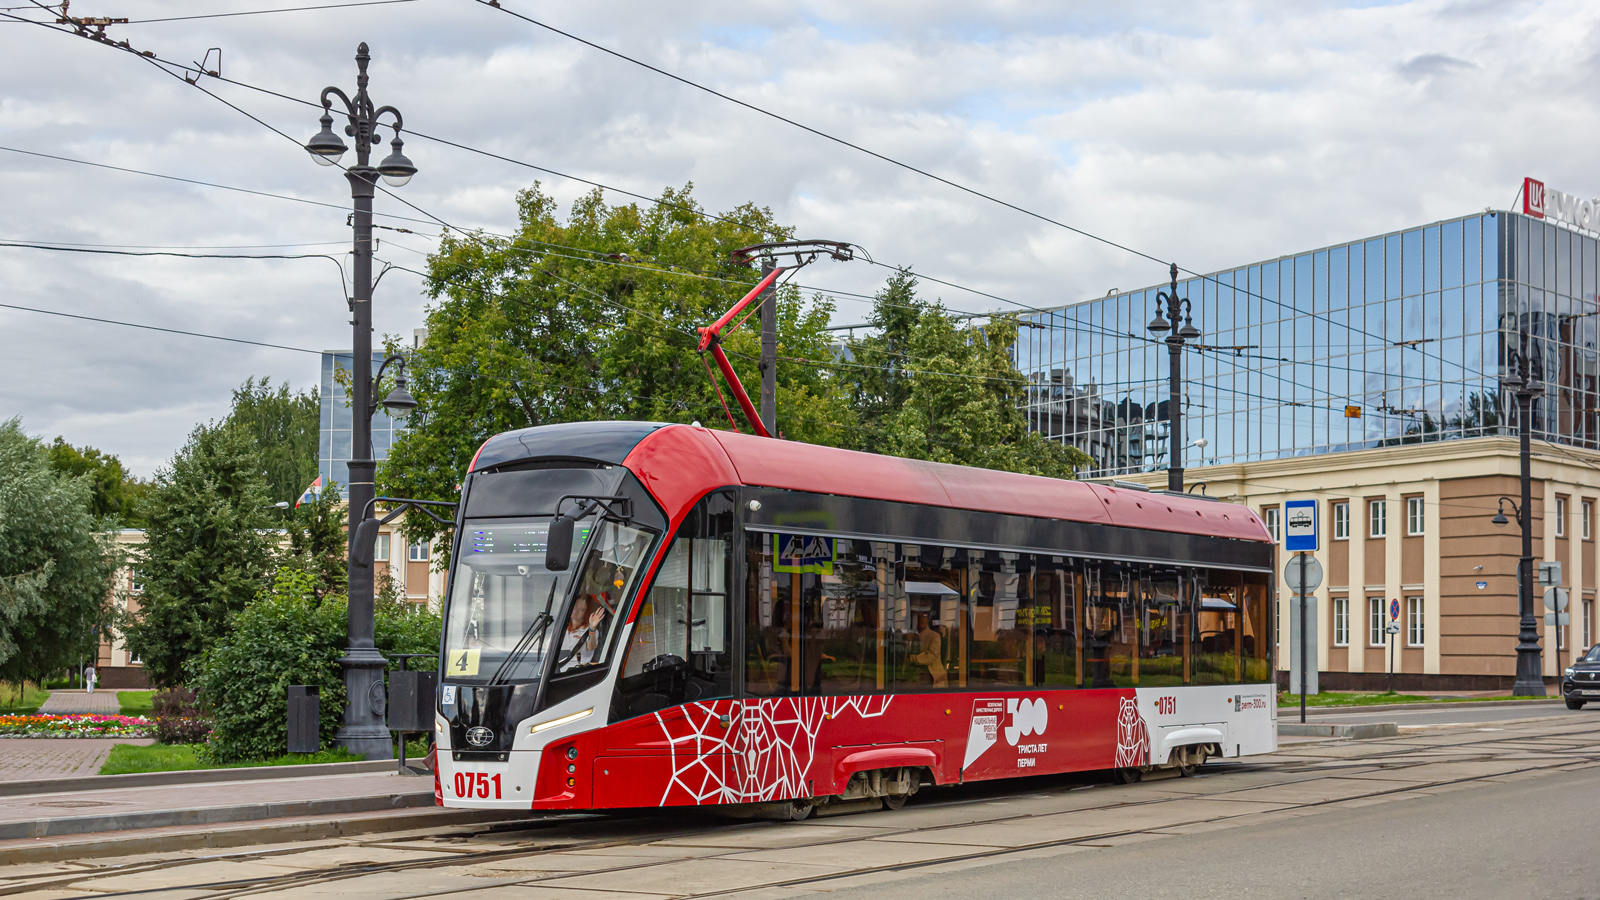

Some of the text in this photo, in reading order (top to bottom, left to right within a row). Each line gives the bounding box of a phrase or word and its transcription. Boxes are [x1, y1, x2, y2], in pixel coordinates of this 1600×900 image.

[455, 651, 468, 671] 4
[1159, 696, 1176, 715] 0751
[1004, 697, 1048, 746] 300
[1018, 743, 1048, 754] ТРИСТА ЛЕТ
[1017, 758, 1036, 768] ПЕРМИ
[454, 772, 502, 799] 0751
